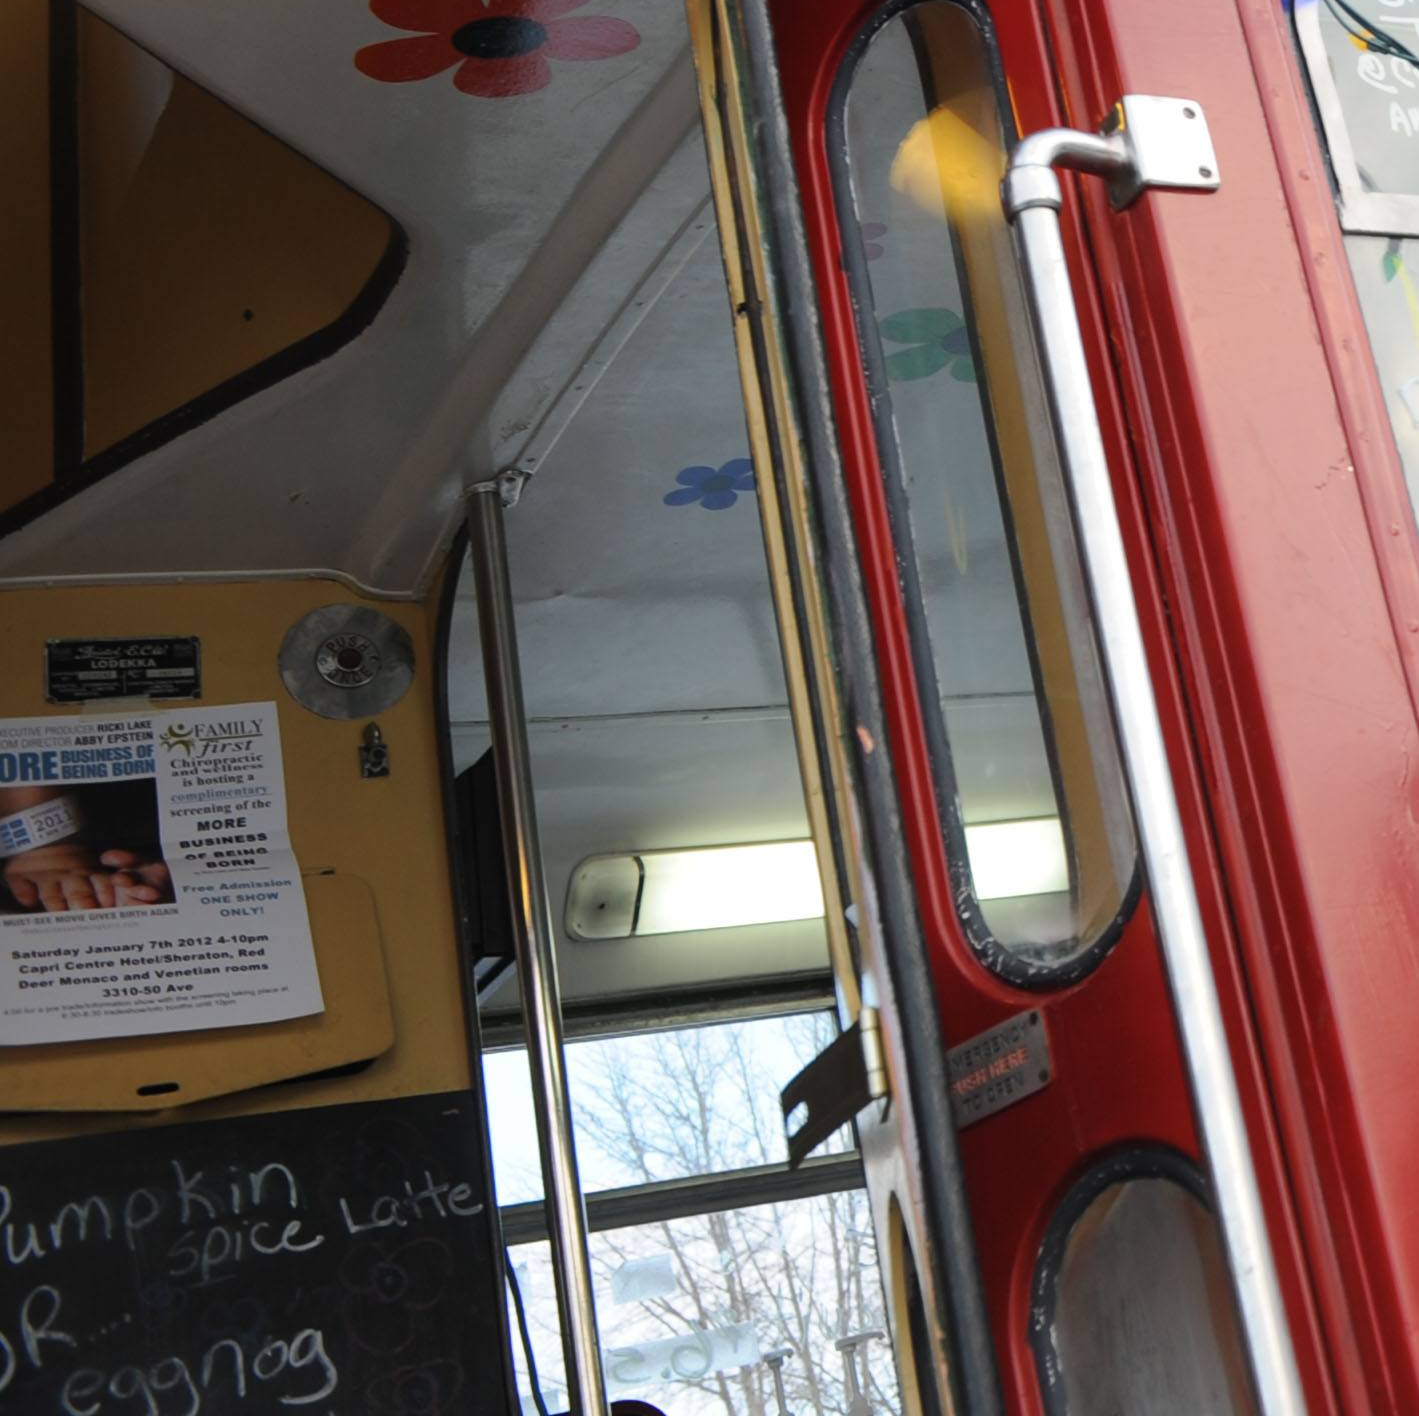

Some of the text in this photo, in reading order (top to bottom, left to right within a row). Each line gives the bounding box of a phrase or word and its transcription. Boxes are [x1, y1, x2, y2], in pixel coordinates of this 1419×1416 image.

[326, 635, 368, 653] PUSH
[97, 720, 153, 733] RICKI LAKE
[193, 719, 264, 739] FAMILY
[74, 732, 154, 746] ABBY EPSTEIN
[196, 738, 254, 758] first
[0, 747, 133, 783] ORE BUSINESS
[62, 759, 156, 780] BEING BORN
[169, 753, 264, 770] Chiropractic
[197, 775, 244, 788] hosting
[170, 786, 268, 803] complimentary
[33, 809, 75, 833] 2011
[196, 816, 247, 832] MORE
[179, 833, 268, 849] BUSINESS
[220, 879, 292, 891] Admission
[236, 891, 280, 903] SHOW
[11, 936, 213, 961] Saturday January 7th 2012
[64, 947, 266, 971] Centre Red
[154, 967, 221, 980] Venetian
[102, 984, 195, 999] 3310-50 Ave
[340, 1170, 484, 1235] Latte
